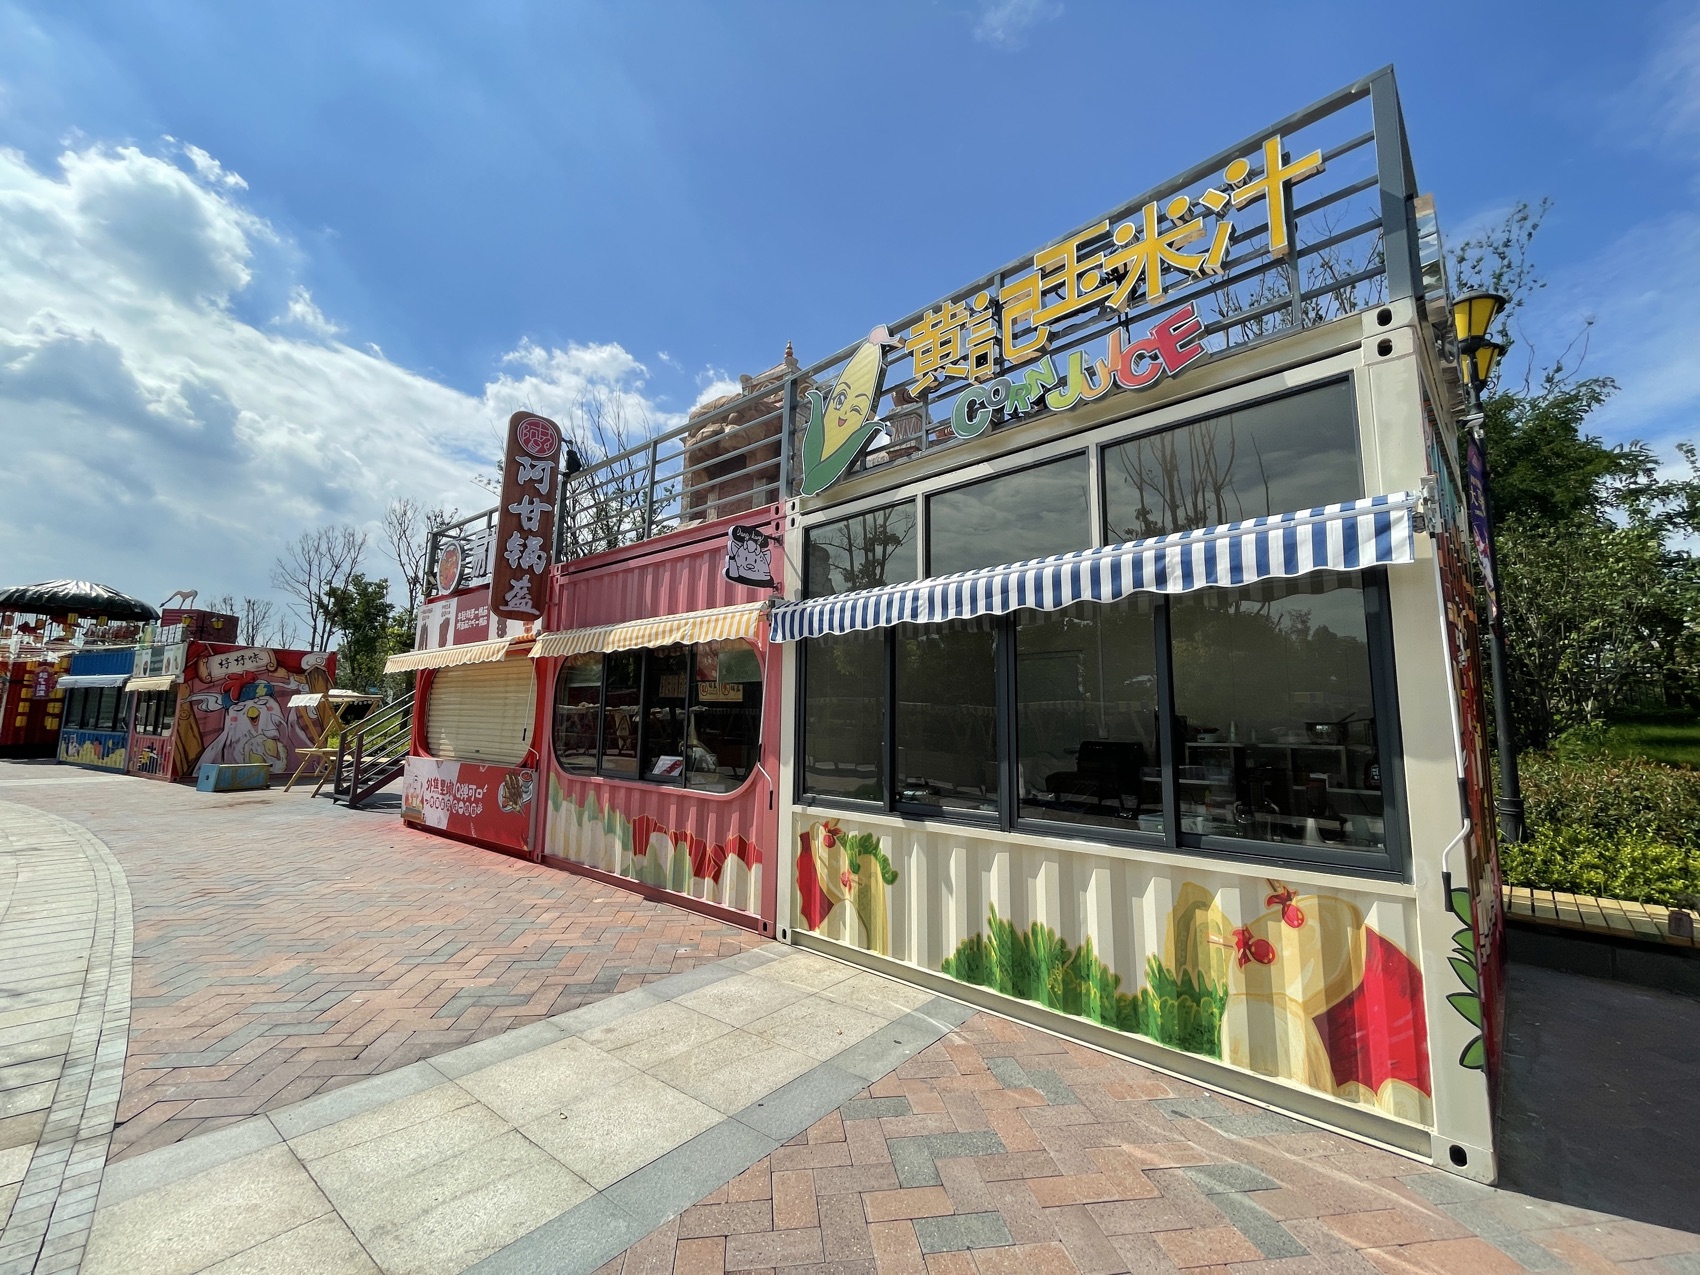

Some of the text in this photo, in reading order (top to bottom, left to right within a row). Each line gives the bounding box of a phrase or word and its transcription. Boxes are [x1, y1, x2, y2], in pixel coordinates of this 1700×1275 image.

[951, 301, 1206, 439] CORN JUICE
[499, 455, 555, 616] 阿甘锅盔
[218, 652, 263, 669] 好好味
